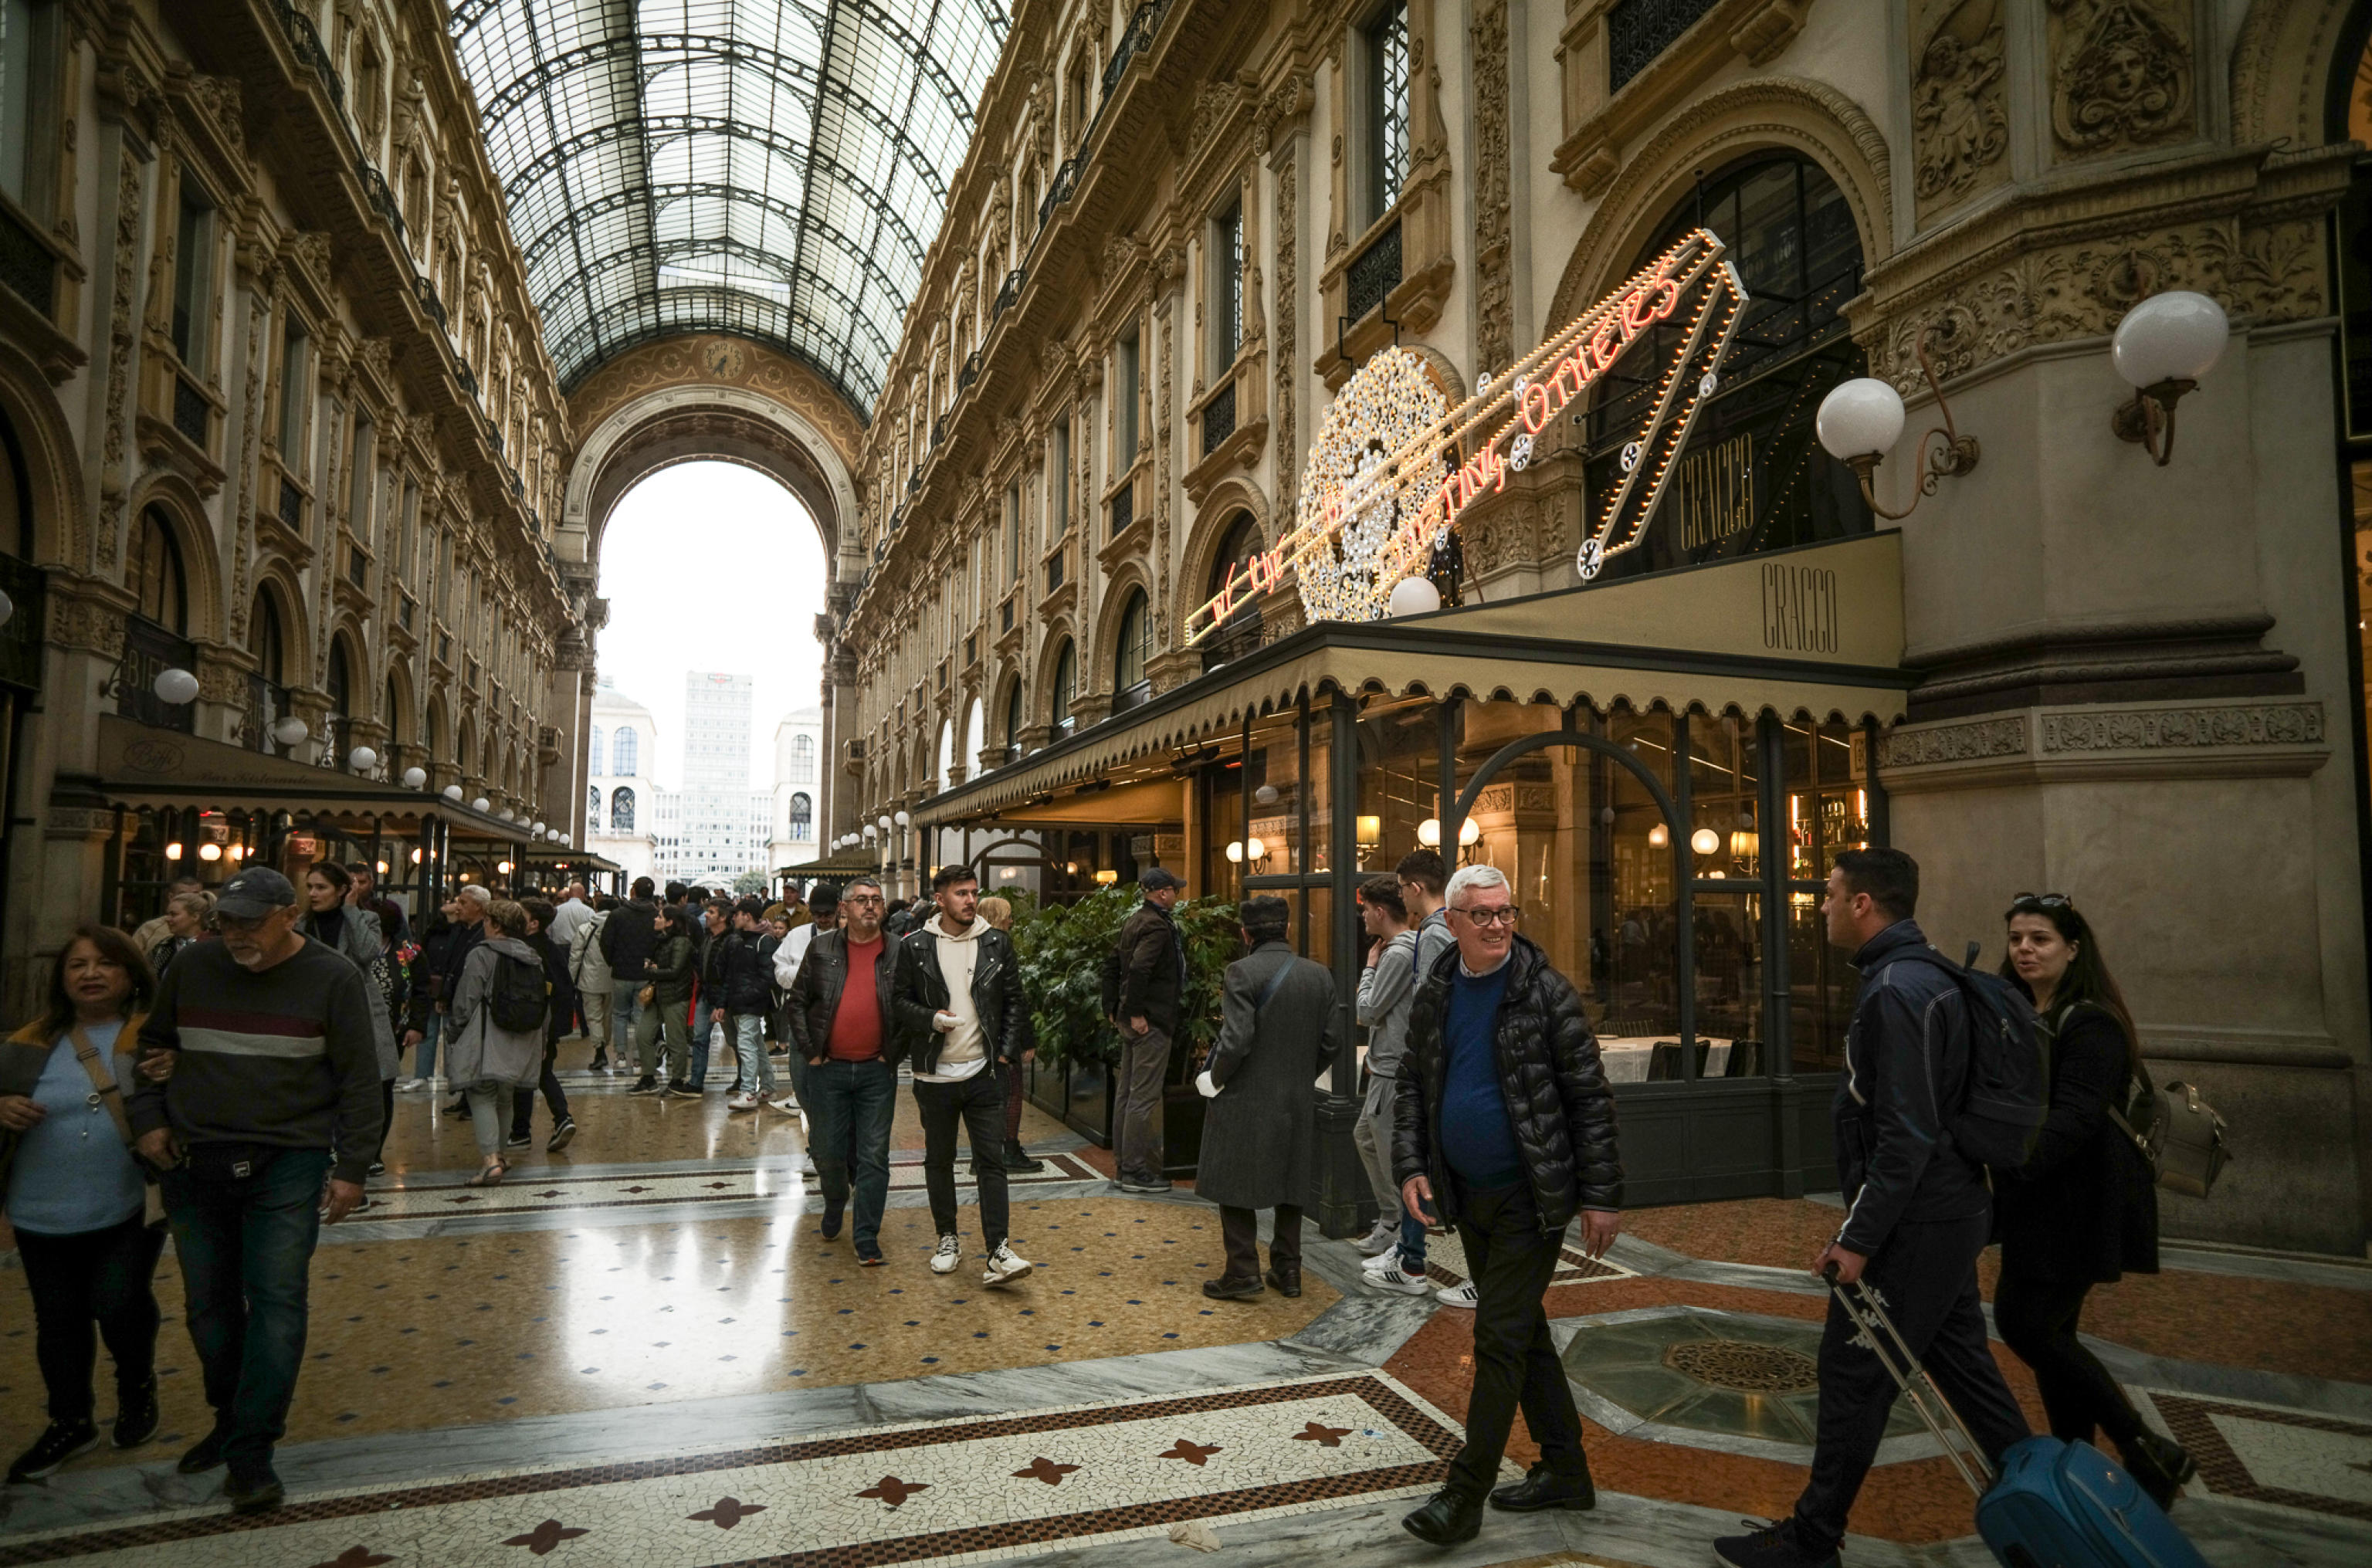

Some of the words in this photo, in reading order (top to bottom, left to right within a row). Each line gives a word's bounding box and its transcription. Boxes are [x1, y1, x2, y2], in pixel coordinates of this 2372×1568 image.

[1521, 256, 1679, 434] OTHERS
[1680, 432, 1754, 551] CRACCO
[1762, 563, 1838, 654] CRACCO
